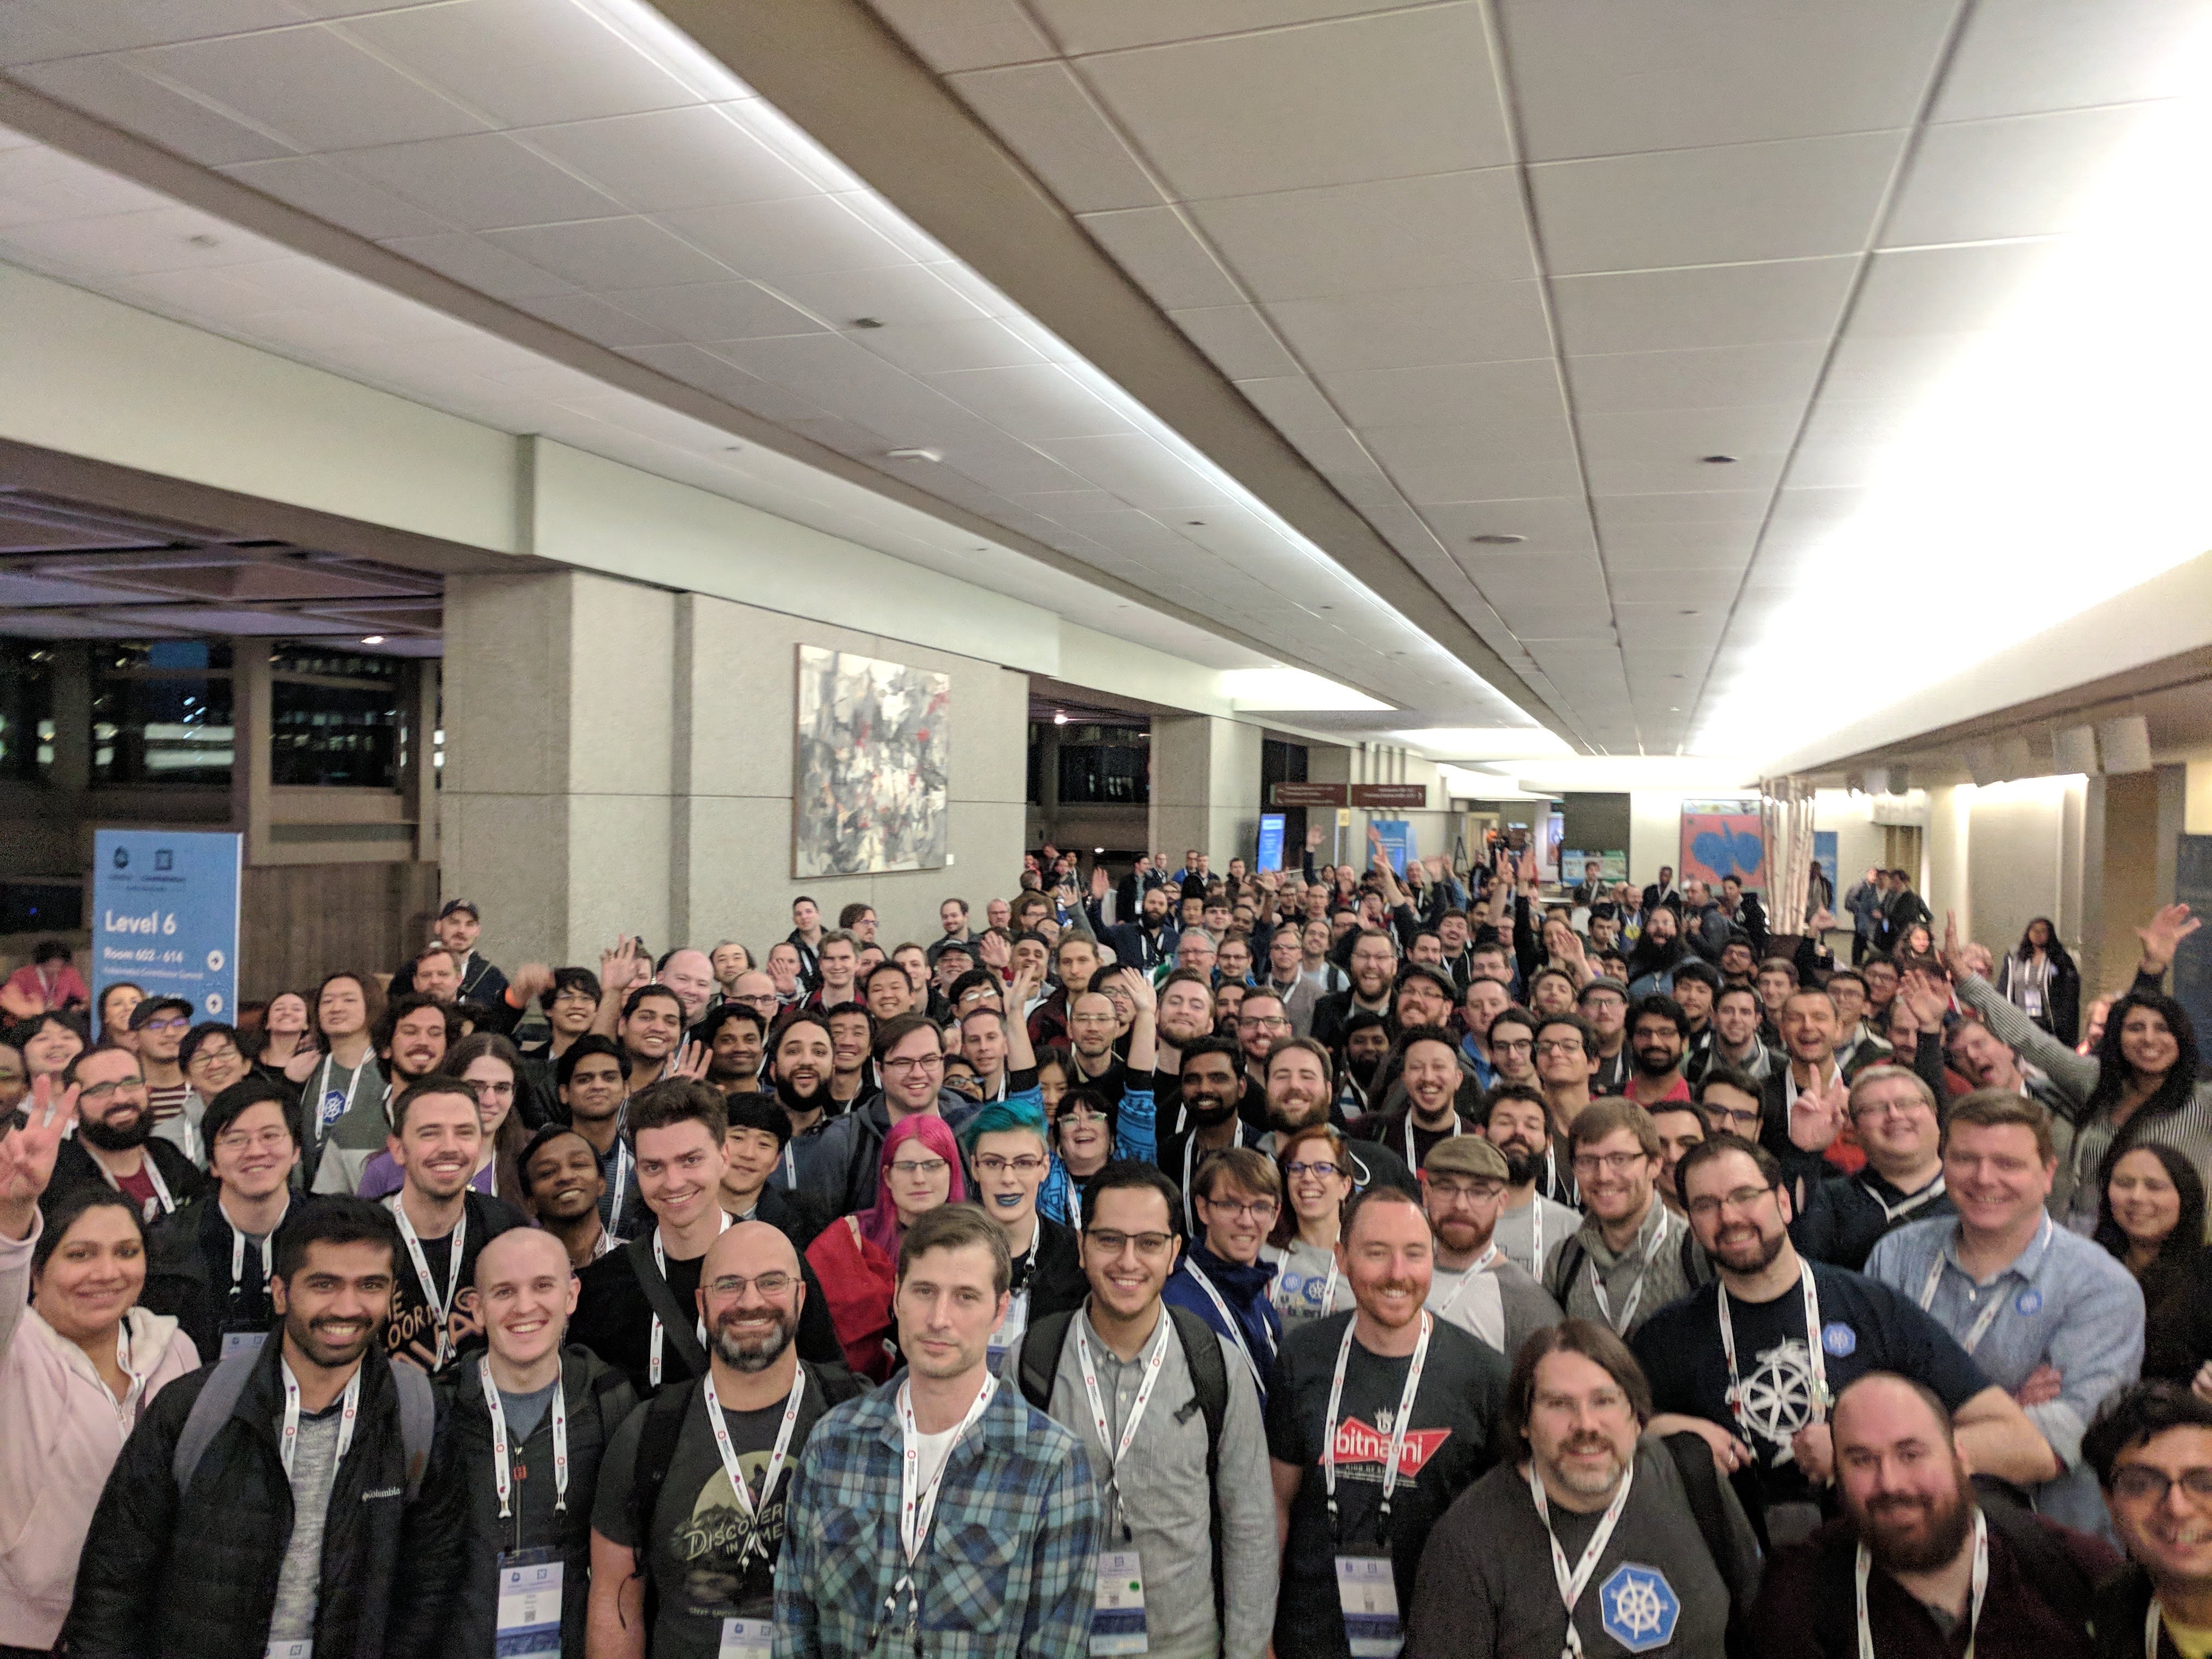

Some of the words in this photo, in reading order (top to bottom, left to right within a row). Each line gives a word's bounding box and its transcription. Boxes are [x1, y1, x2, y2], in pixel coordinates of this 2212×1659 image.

[105, 910, 158, 934] Level
[163, 913, 177, 936] 6
[1336, 1425, 1423, 1464] bitnami
